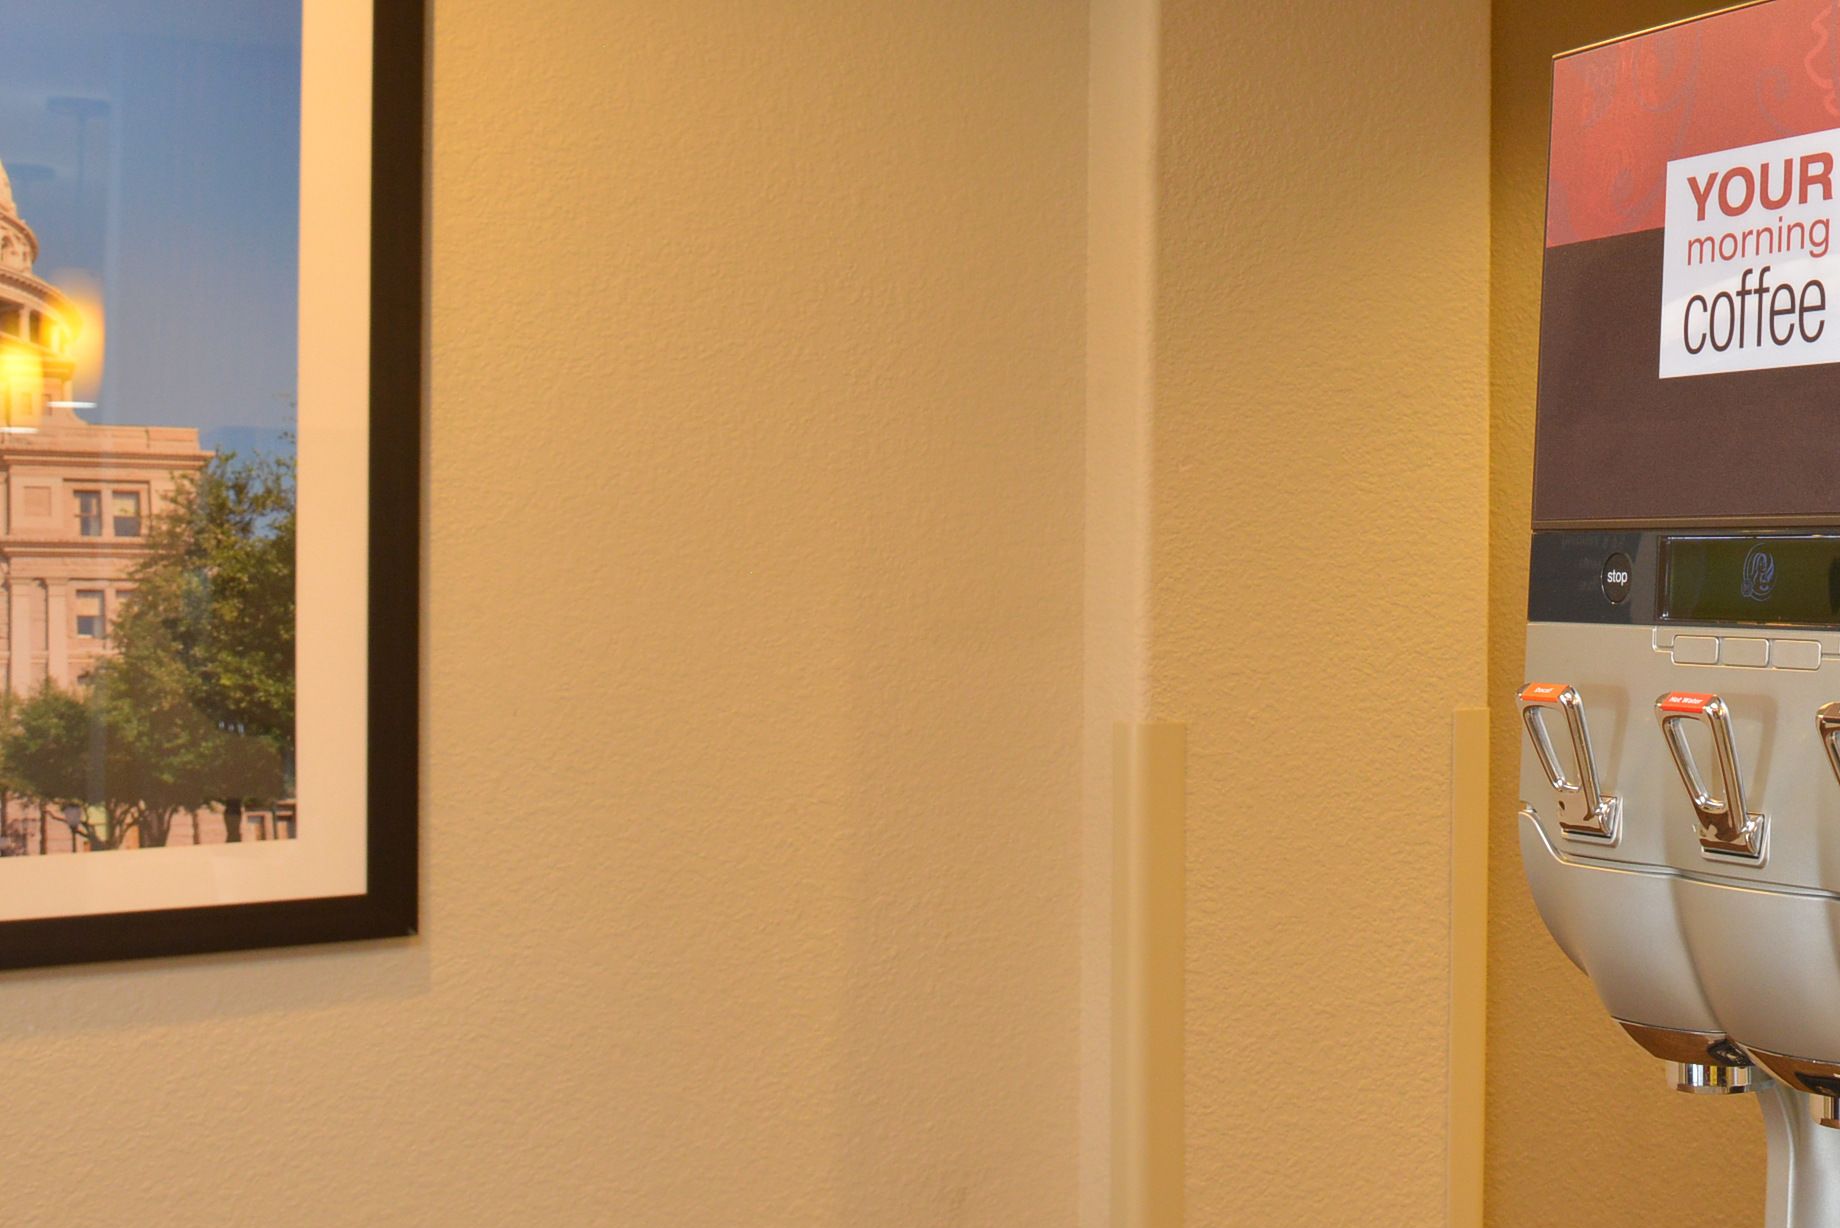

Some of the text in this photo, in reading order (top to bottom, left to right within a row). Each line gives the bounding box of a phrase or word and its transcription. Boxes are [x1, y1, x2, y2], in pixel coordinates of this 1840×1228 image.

[1686, 151, 1834, 222] YOUR
[1687, 216, 1831, 266] morning
[1683, 265, 1827, 355] coffee
[1606, 569, 1628, 587] stop
